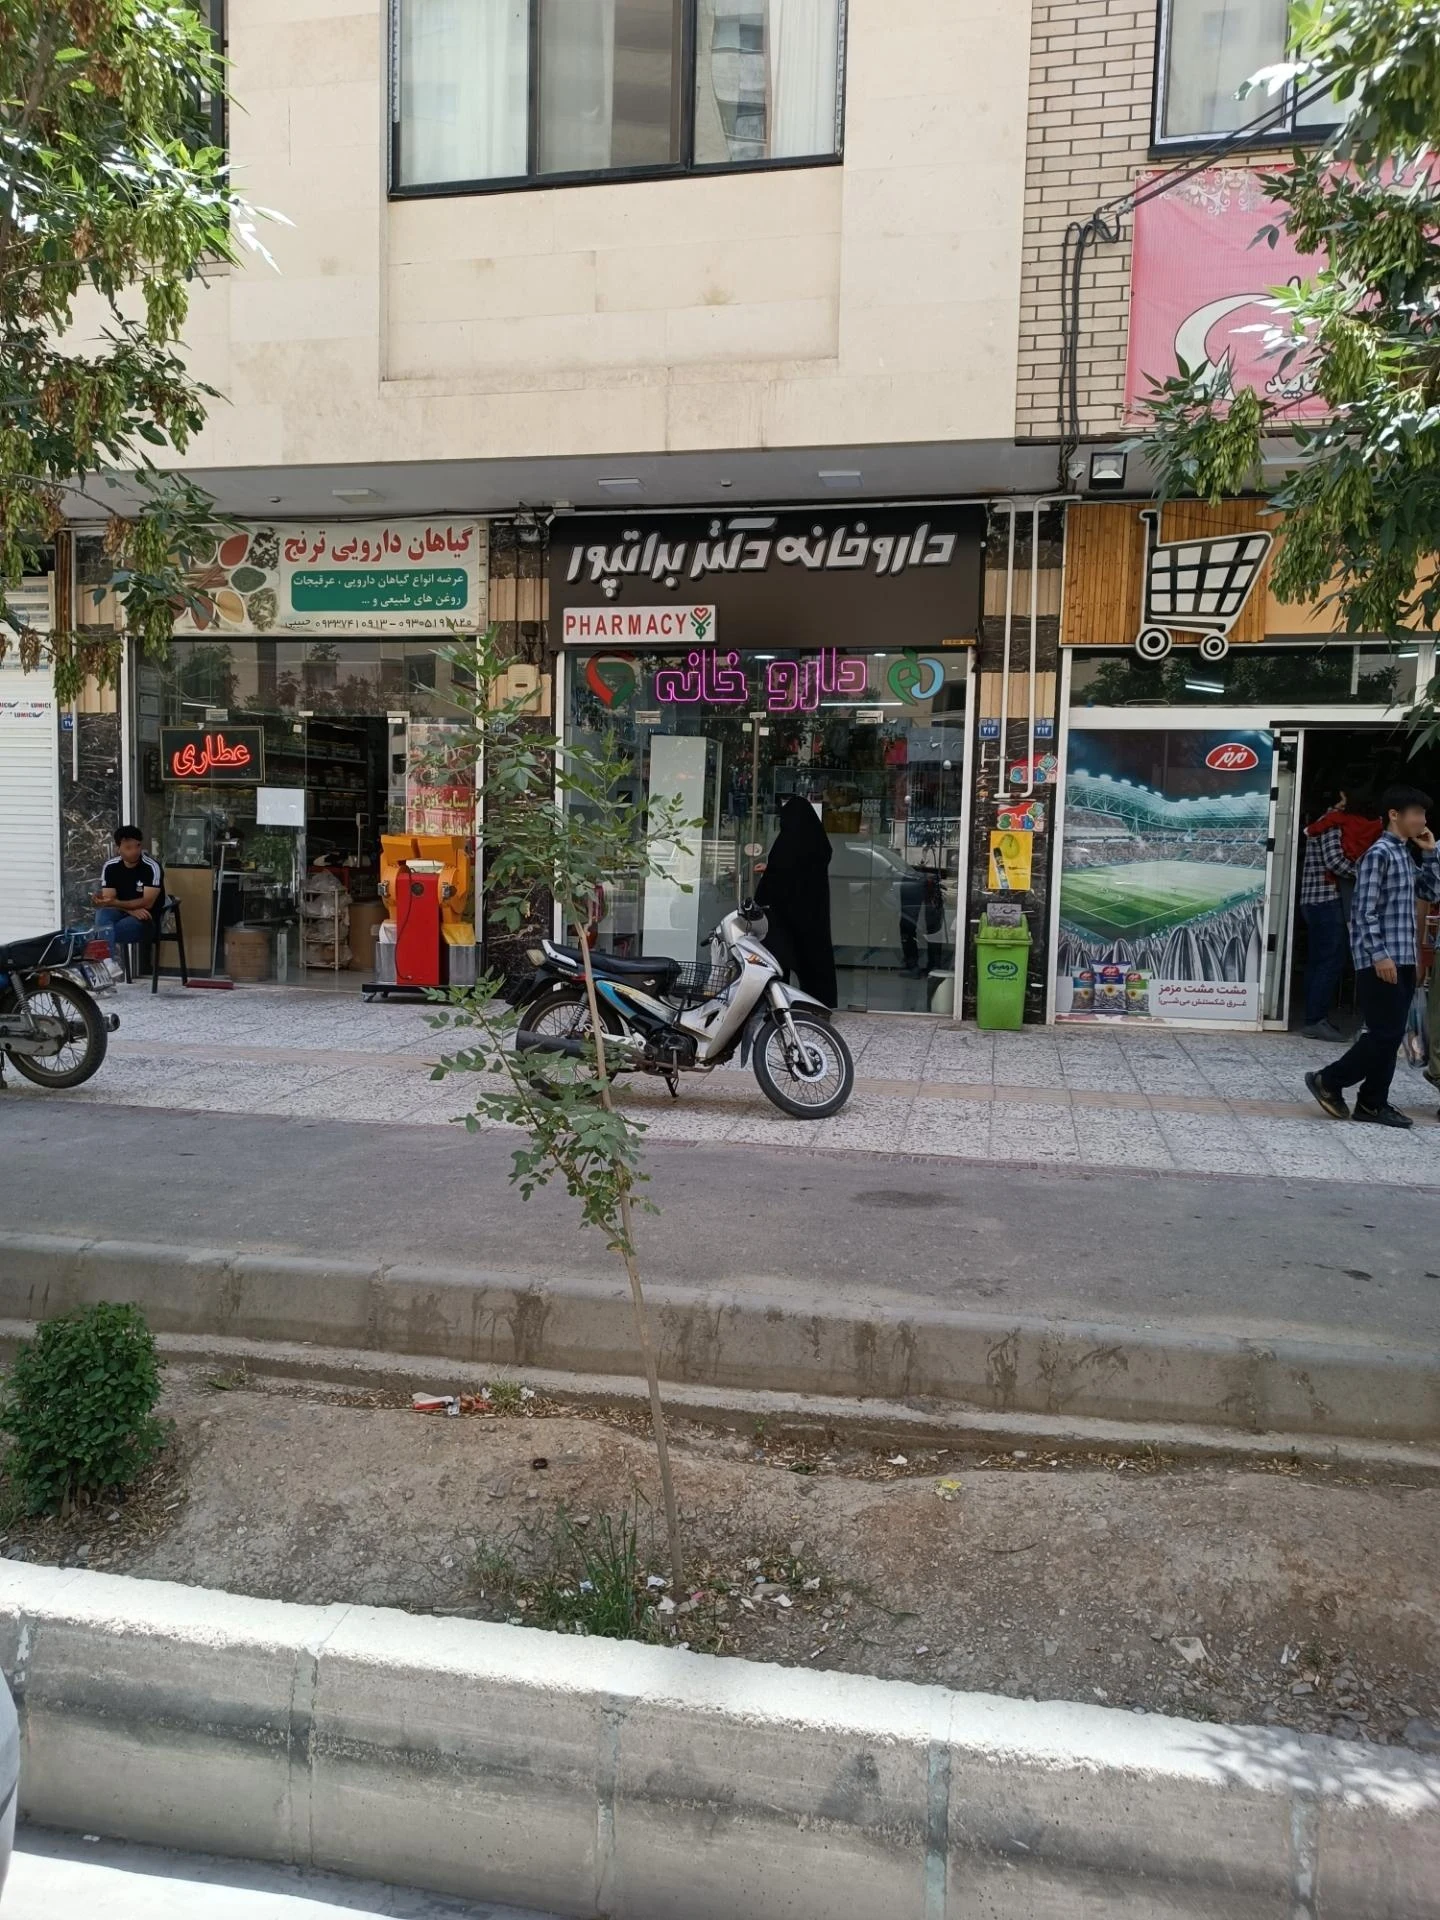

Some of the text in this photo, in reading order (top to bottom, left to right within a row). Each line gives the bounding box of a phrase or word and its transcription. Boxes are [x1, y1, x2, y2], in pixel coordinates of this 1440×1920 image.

[284, 526, 474, 562] گیاهان دارویی ترنج
[689, 517, 777, 580] دکتر
[566, 529, 686, 600] براتپور
[293, 575, 335, 588] عرقیجات
[344, 574, 375, 588] دارویی
[378, 573, 410, 588] گیاهان
[412, 573, 434, 587] انواع
[437, 573, 464, 586] عرضه
[372, 598, 378, 606] و
[380, 594, 411, 607] طبیعی
[413, 593, 432, 606] های
[435, 592, 461, 606] روغن
[565, 613, 687, 635] PHARMACY
[174, 734, 250, 775] عطاری
[1214, 747, 1248, 767] مزمز
[1158, 984, 1247, 996] مشت مشت مزمز
